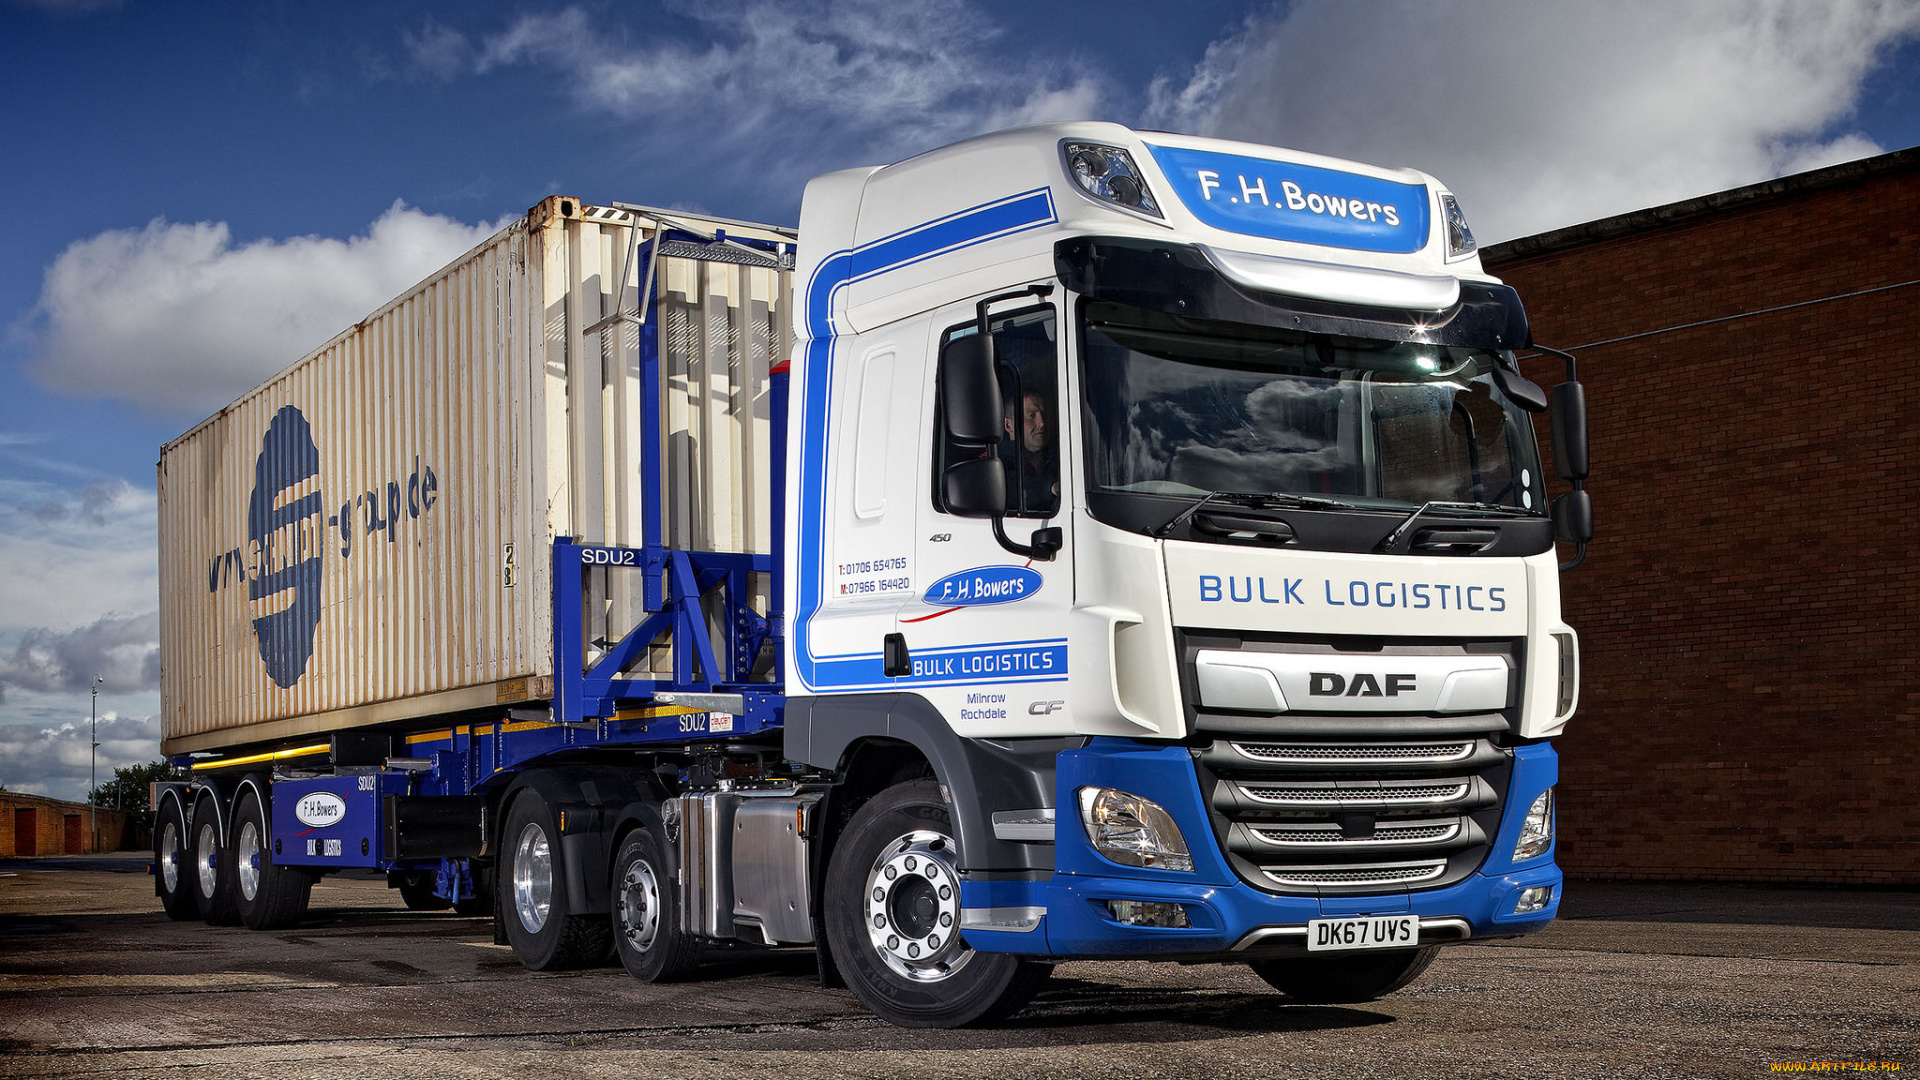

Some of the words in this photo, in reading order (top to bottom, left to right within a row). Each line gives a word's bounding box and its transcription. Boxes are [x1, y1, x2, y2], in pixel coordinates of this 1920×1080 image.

[929, 533, 952, 543] 450
[581, 549, 635, 566] SDU2
[873, 557, 907, 571] 654765
[878, 577, 910, 591] 164420
[1199, 575, 1305, 605] BULK
[1325, 579, 1506, 612] LOGISTICS
[913, 657, 954, 676] BULK
[962, 651, 1053, 673] LOGISTICS
[1309, 672, 1417, 697] DAF
[966, 693, 1006, 704] Milnrow
[960, 708, 1007, 720] Rochdale
[1028, 700, 1065, 716] CF
[679, 712, 705, 732] SDU2
[358, 775, 374, 791] SDU2
[1316, 921, 1369, 946] DK67
[1374, 919, 1411, 943] UVS
